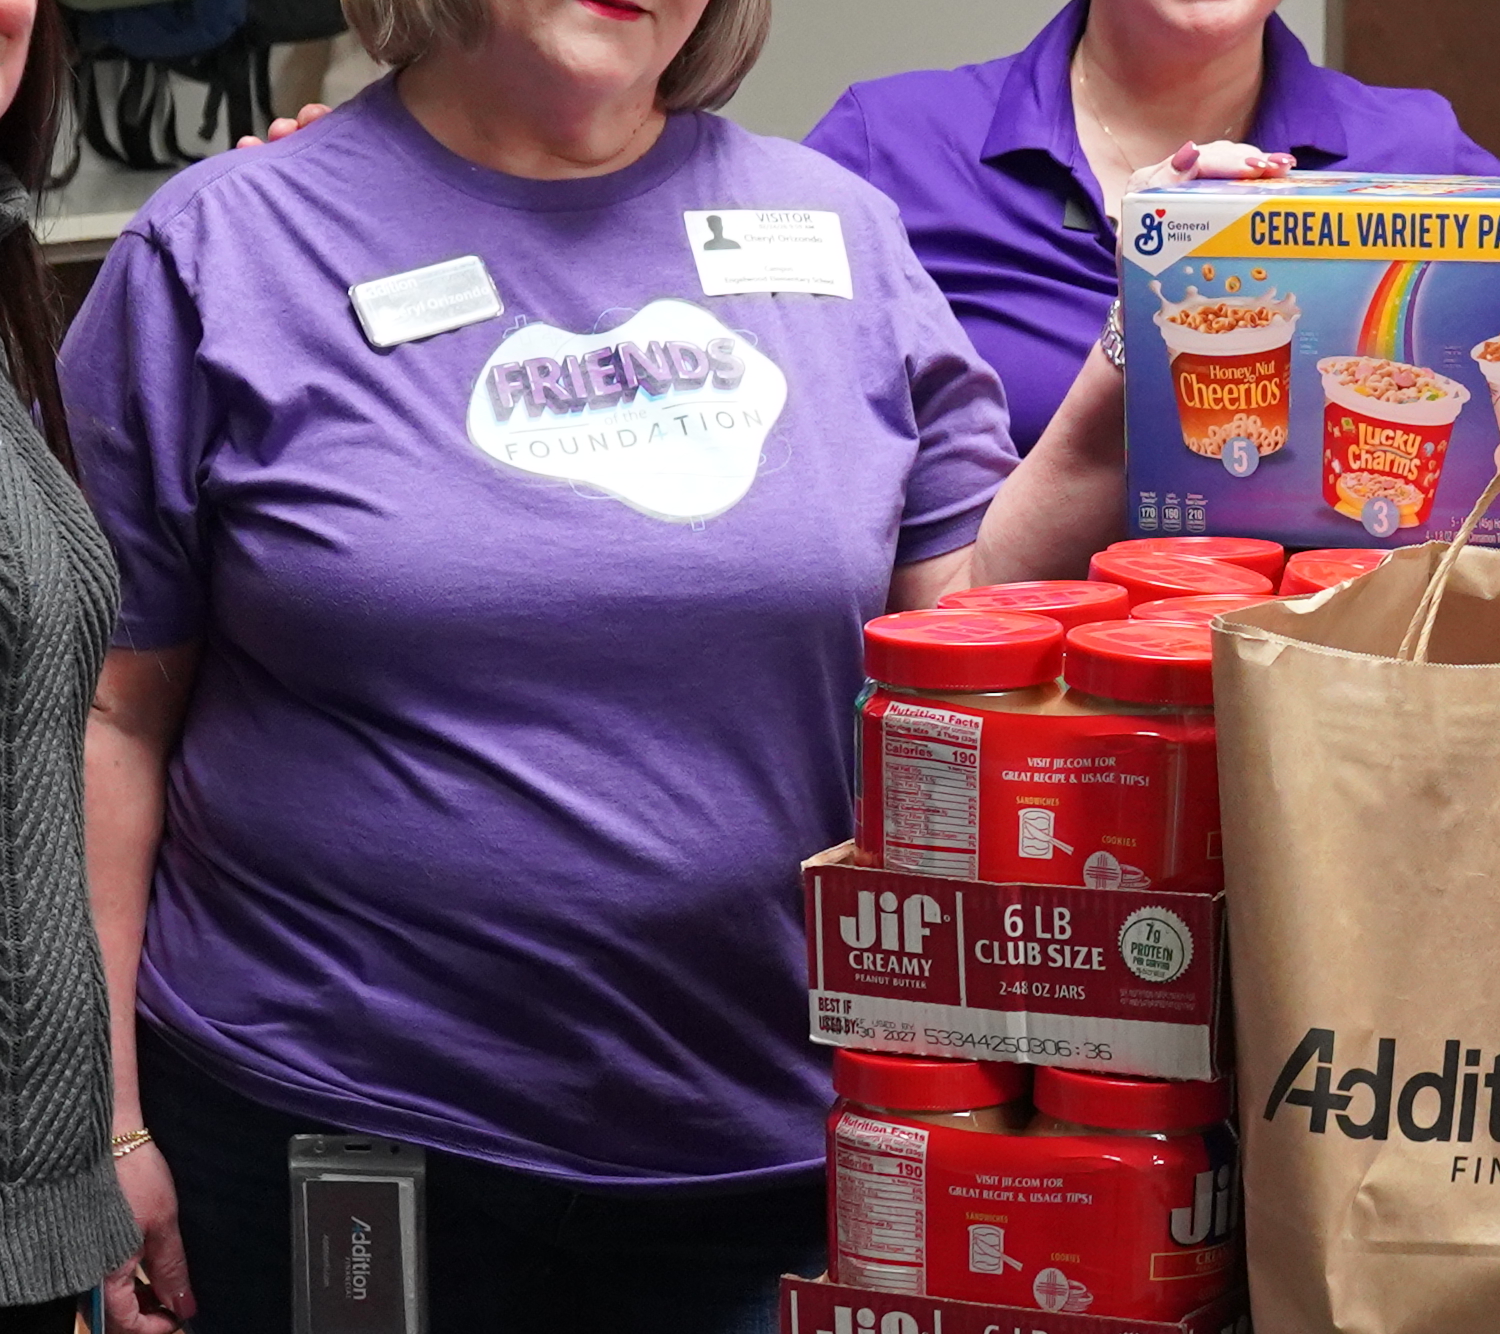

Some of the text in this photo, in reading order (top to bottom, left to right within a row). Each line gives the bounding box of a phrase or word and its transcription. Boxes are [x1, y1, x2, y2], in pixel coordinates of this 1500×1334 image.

[756, 212, 813, 223] VISITOR
[1167, 220, 1210, 232] General
[1250, 210, 1350, 247] CEREAL
[1357, 212, 1470, 249] VARIETY
[743, 233, 774, 244] Cheryl
[1167, 232, 1192, 243] Mills
[427, 285, 489, 310] Orizondo
[485, 338, 746, 424] FRIENDS
[1209, 360, 1276, 383] Honey Nut
[1179, 371, 1281, 410] Cheerios
[505, 408, 764, 462] FOUNDATION
[1357, 422, 1423, 459] Lucky
[1232, 440, 1248, 474] 5
[1347, 447, 1422, 481] Charms
[1372, 500, 1389, 533] 3
[1081, 773, 1150, 787] USAGE TIPS!
[839, 890, 942, 955] Jif
[1003, 904, 1072, 940] 6 LB
[848, 950, 933, 978] CREAMY
[974, 939, 1106, 971] CLUB SIZE
[1130, 941, 1173, 962] PROTEIN
[818, 997, 840, 1014] BEST
[999, 981, 1087, 1001] 2-48 OZ JARS
[351, 1215, 372, 1301] Addition
